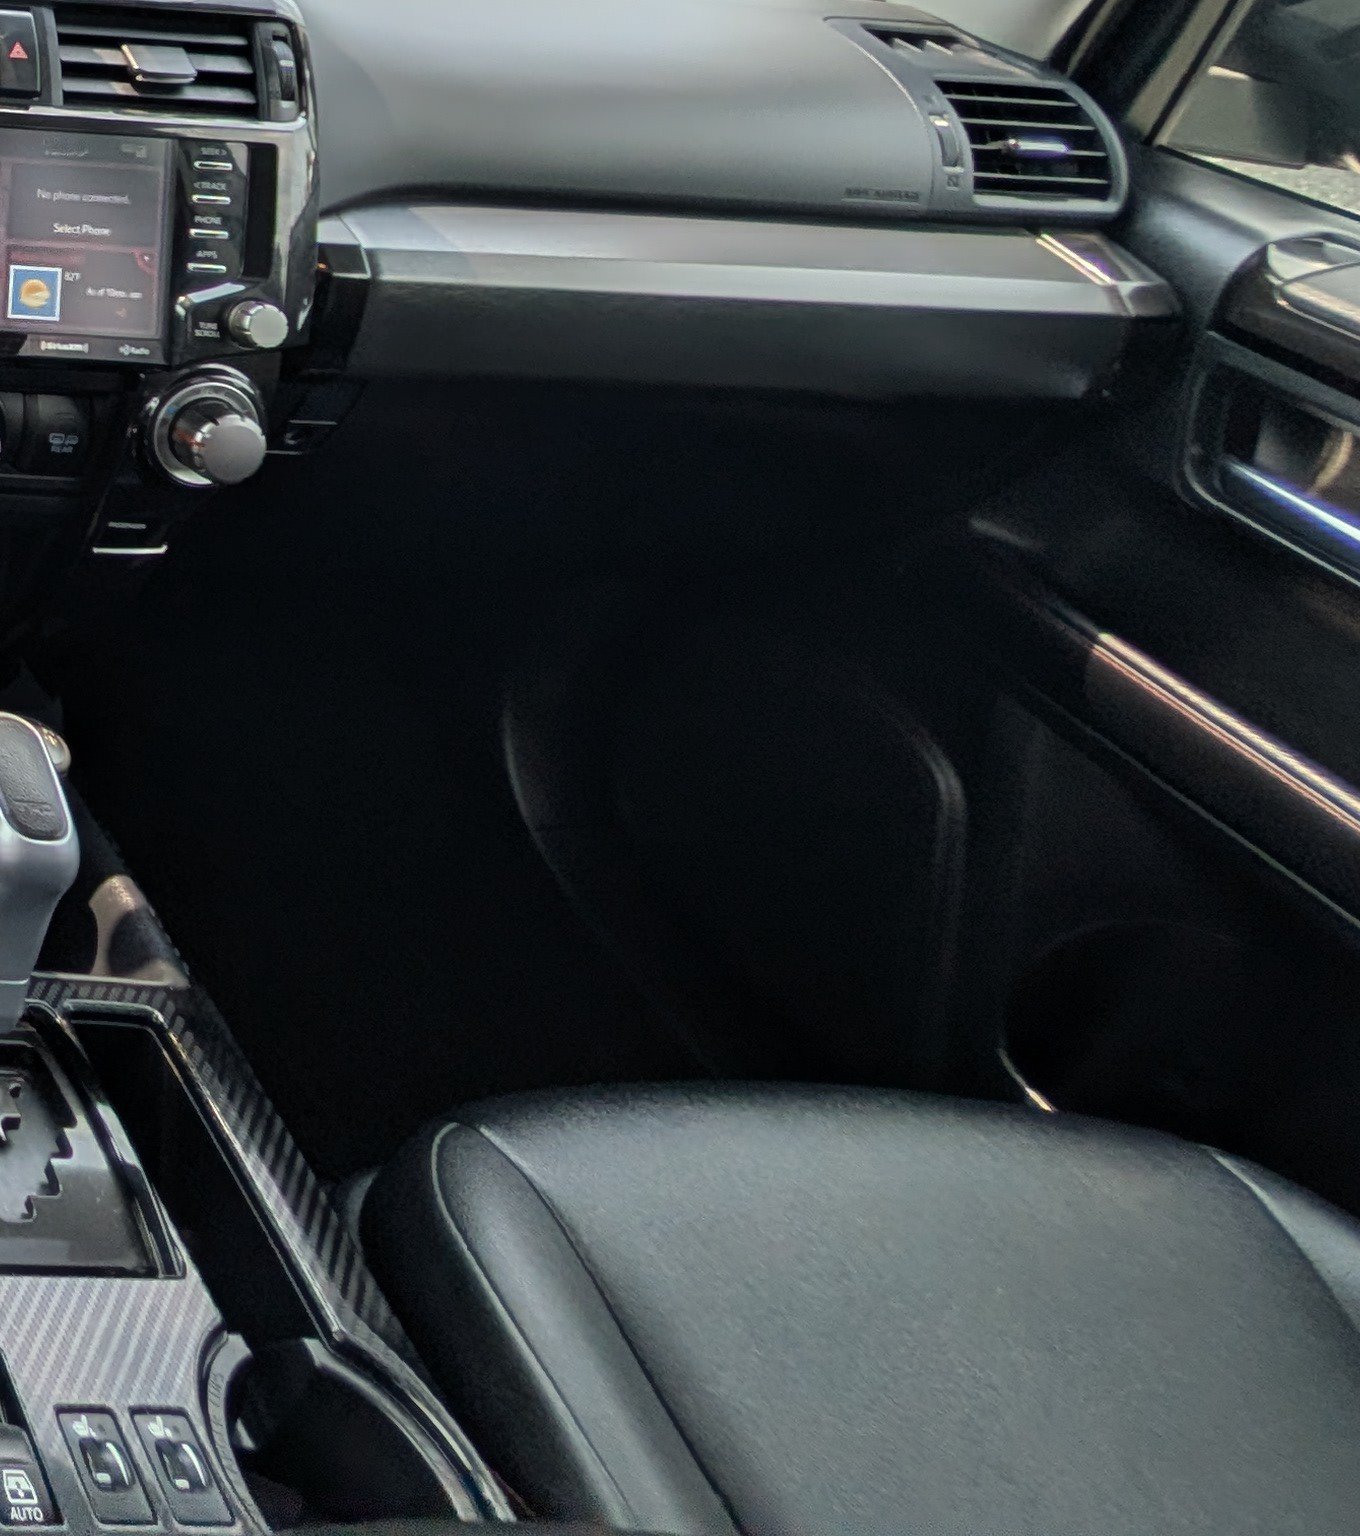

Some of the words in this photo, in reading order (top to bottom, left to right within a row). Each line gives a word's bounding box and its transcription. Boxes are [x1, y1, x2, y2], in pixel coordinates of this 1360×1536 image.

[194, 216, 222, 225] PHONE
[53, 222, 80, 234] Select
[196, 250, 218, 259] APPS
[11, 1507, 44, 1523] AUTO
